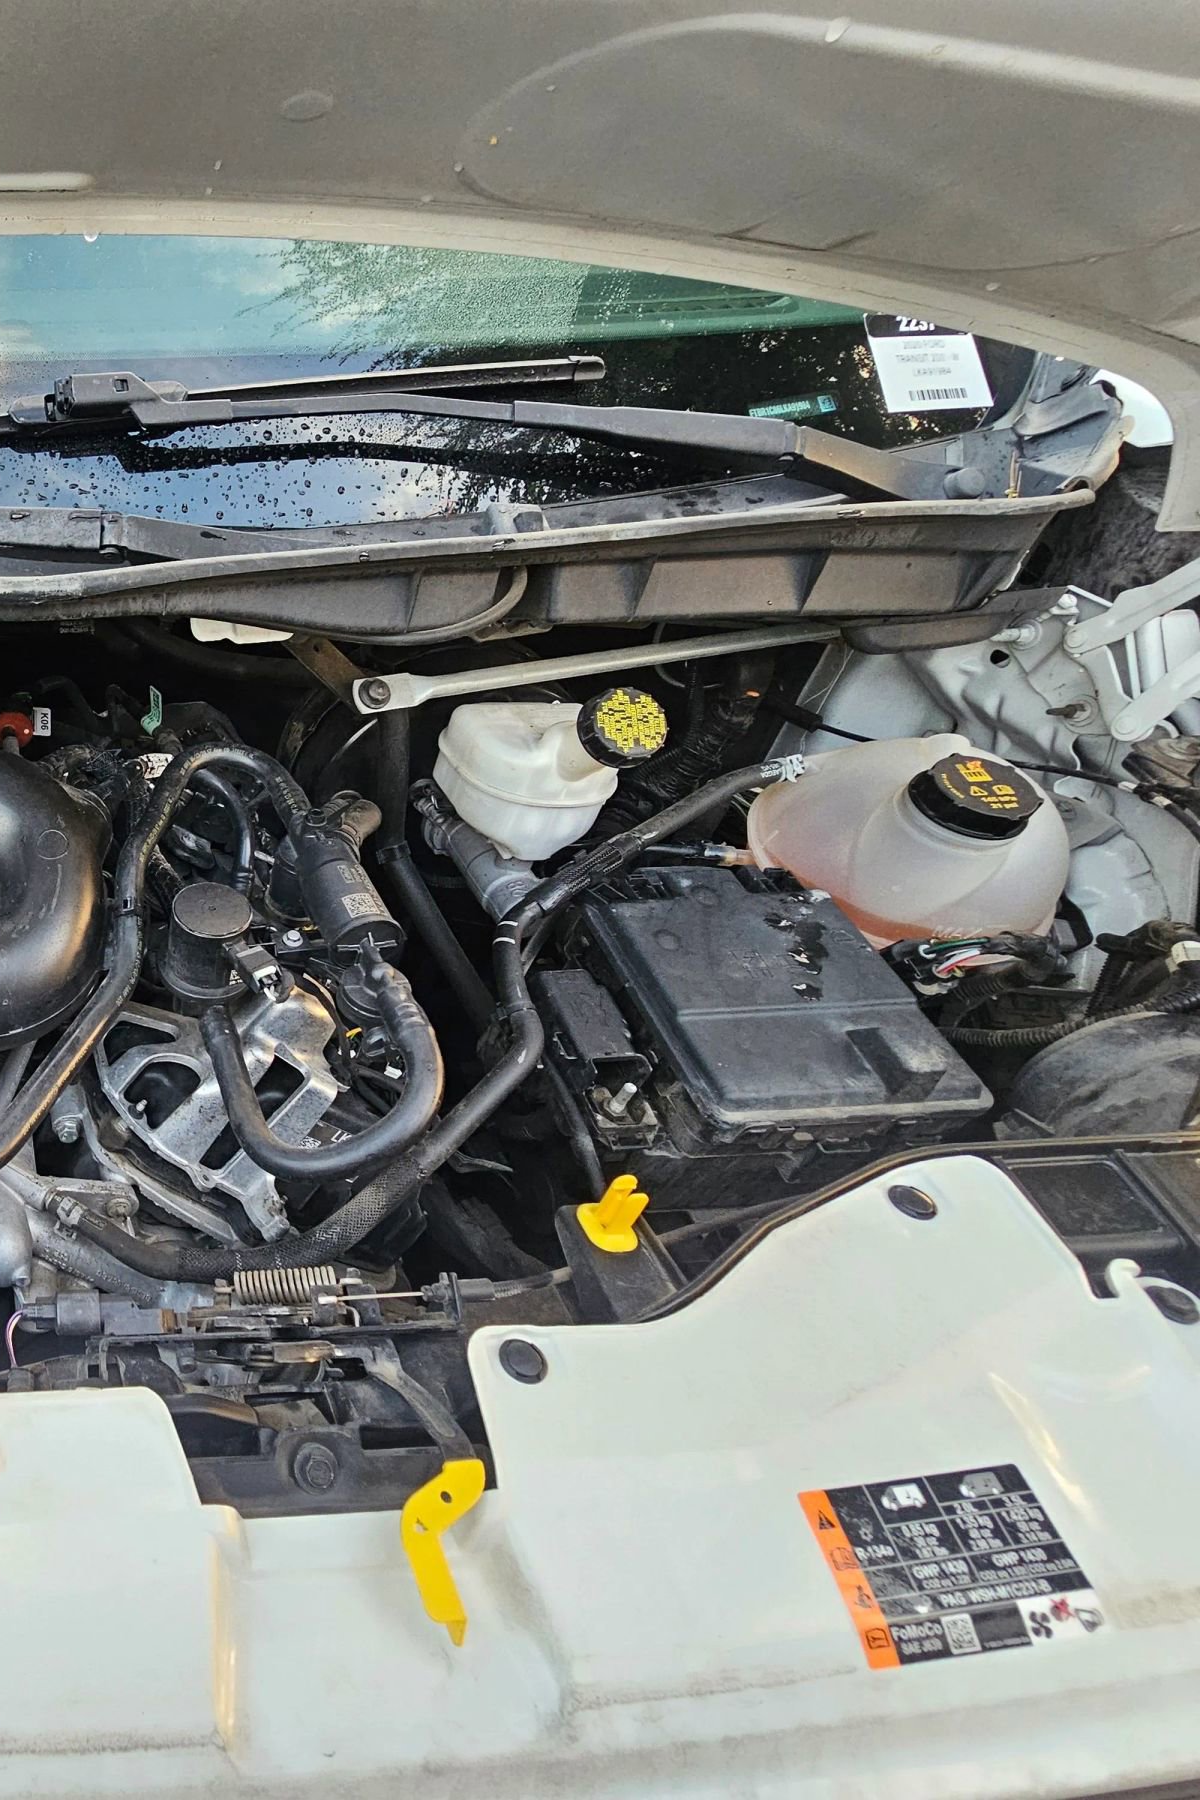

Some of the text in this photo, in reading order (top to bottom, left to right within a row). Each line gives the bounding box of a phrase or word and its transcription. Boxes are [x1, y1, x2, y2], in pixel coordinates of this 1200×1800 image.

[40, 712, 49, 731] K06
[991, 1552, 1022, 1566] GWP
[913, 1564, 943, 1578] GWP
[939, 1593, 967, 1607] PAG
[891, 1622, 943, 1640] FoMoCo
